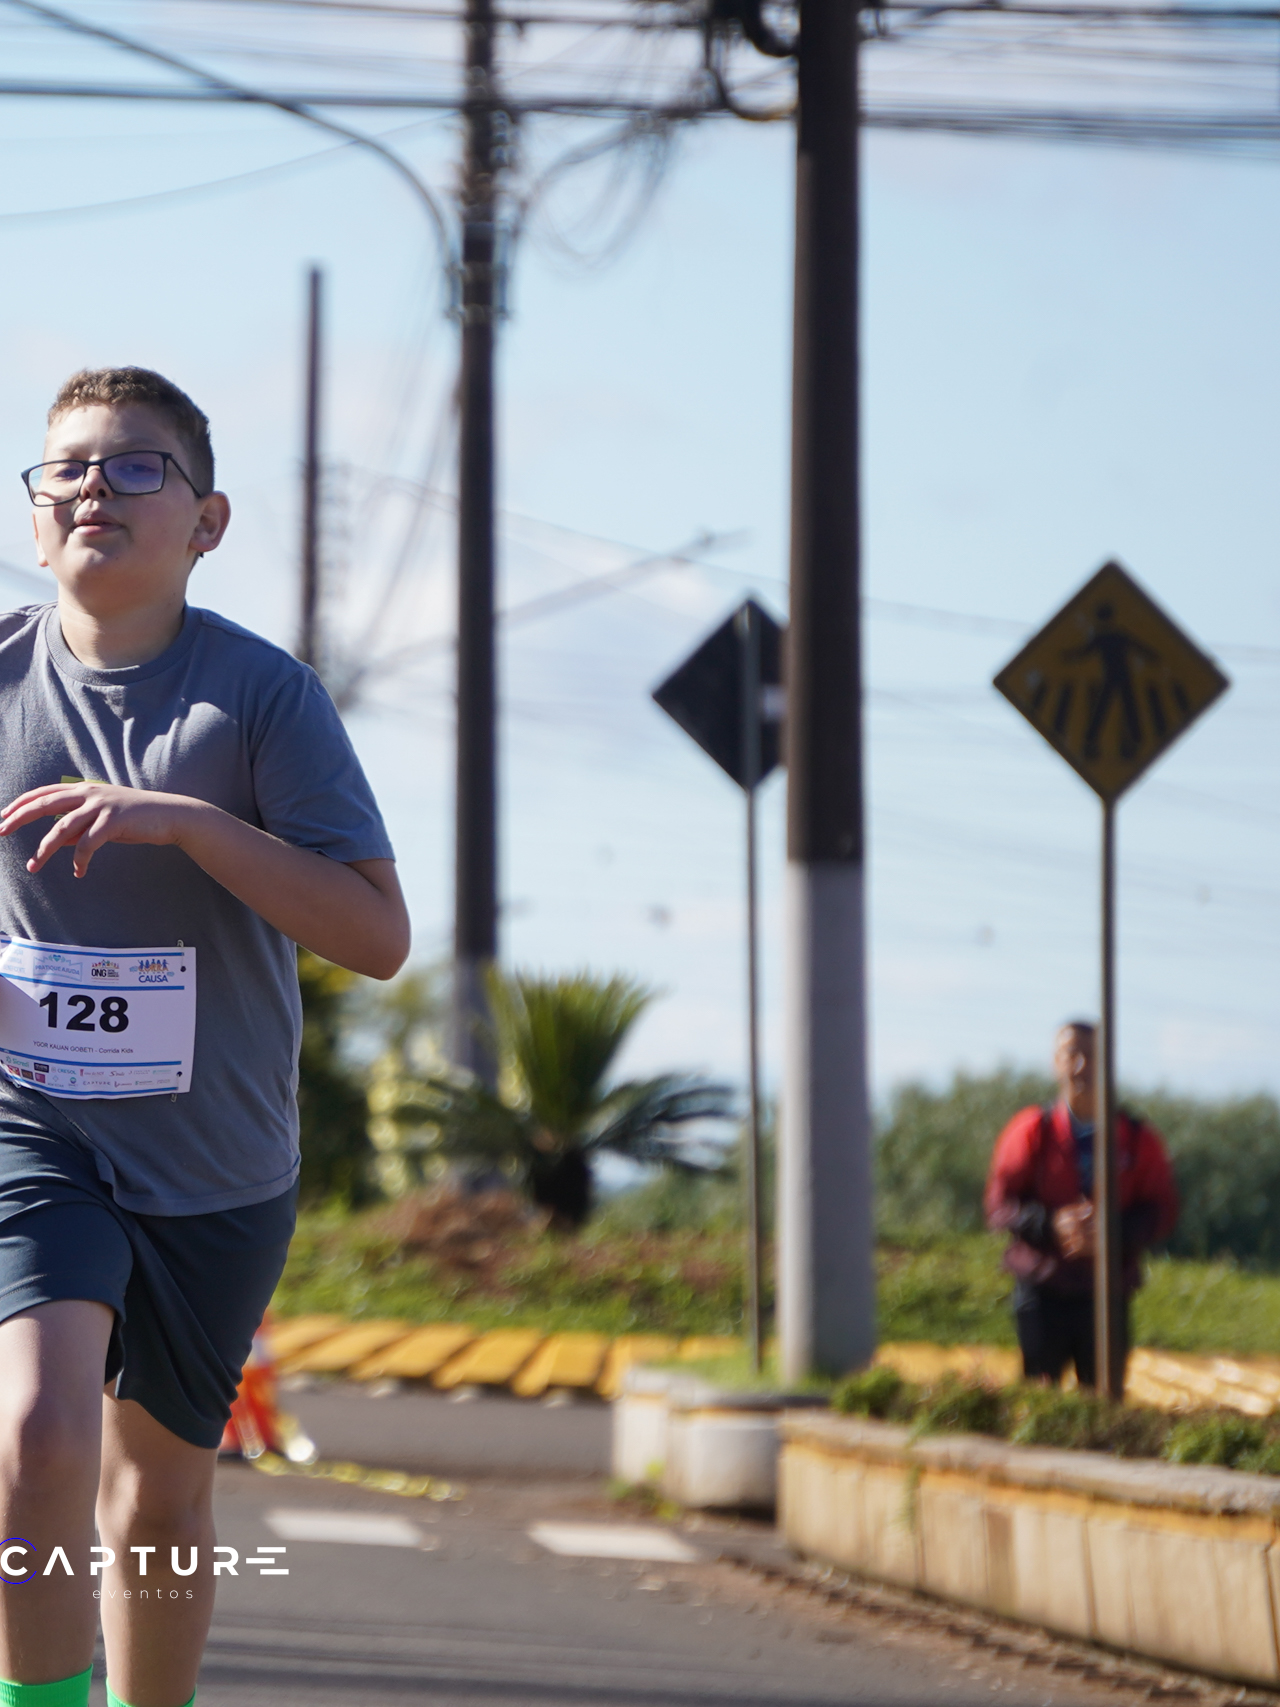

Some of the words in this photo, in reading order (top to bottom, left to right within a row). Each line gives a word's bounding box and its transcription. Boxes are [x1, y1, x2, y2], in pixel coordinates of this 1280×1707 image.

[91, 968, 107, 977] ONG
[138, 974, 169, 983] CAUSA
[39, 991, 129, 1034] 128
